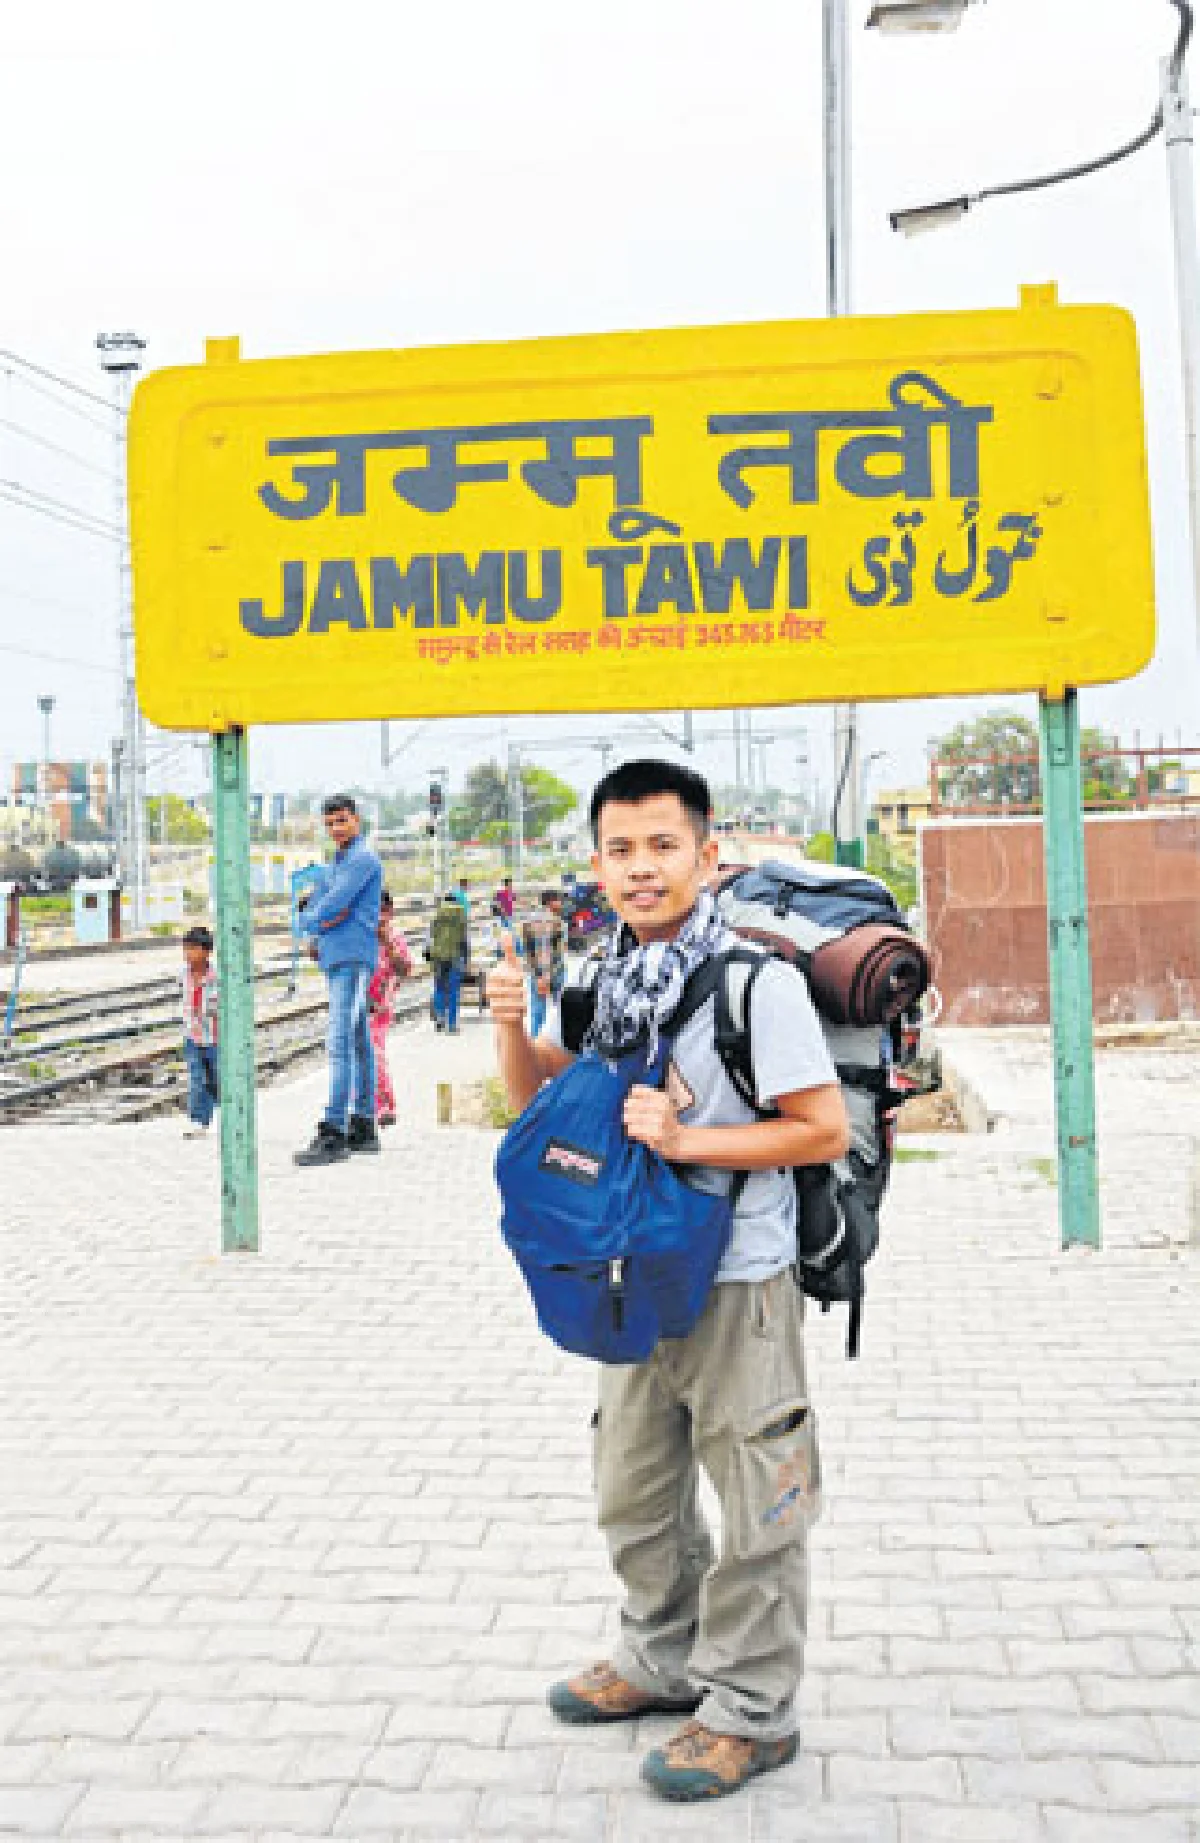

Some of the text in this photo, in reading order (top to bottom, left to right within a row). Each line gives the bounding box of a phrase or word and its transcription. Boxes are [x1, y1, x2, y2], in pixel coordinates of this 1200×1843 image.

[257, 370, 994, 540] जम्मू तवी
[239, 534, 809, 638] JAMMU TAWI
